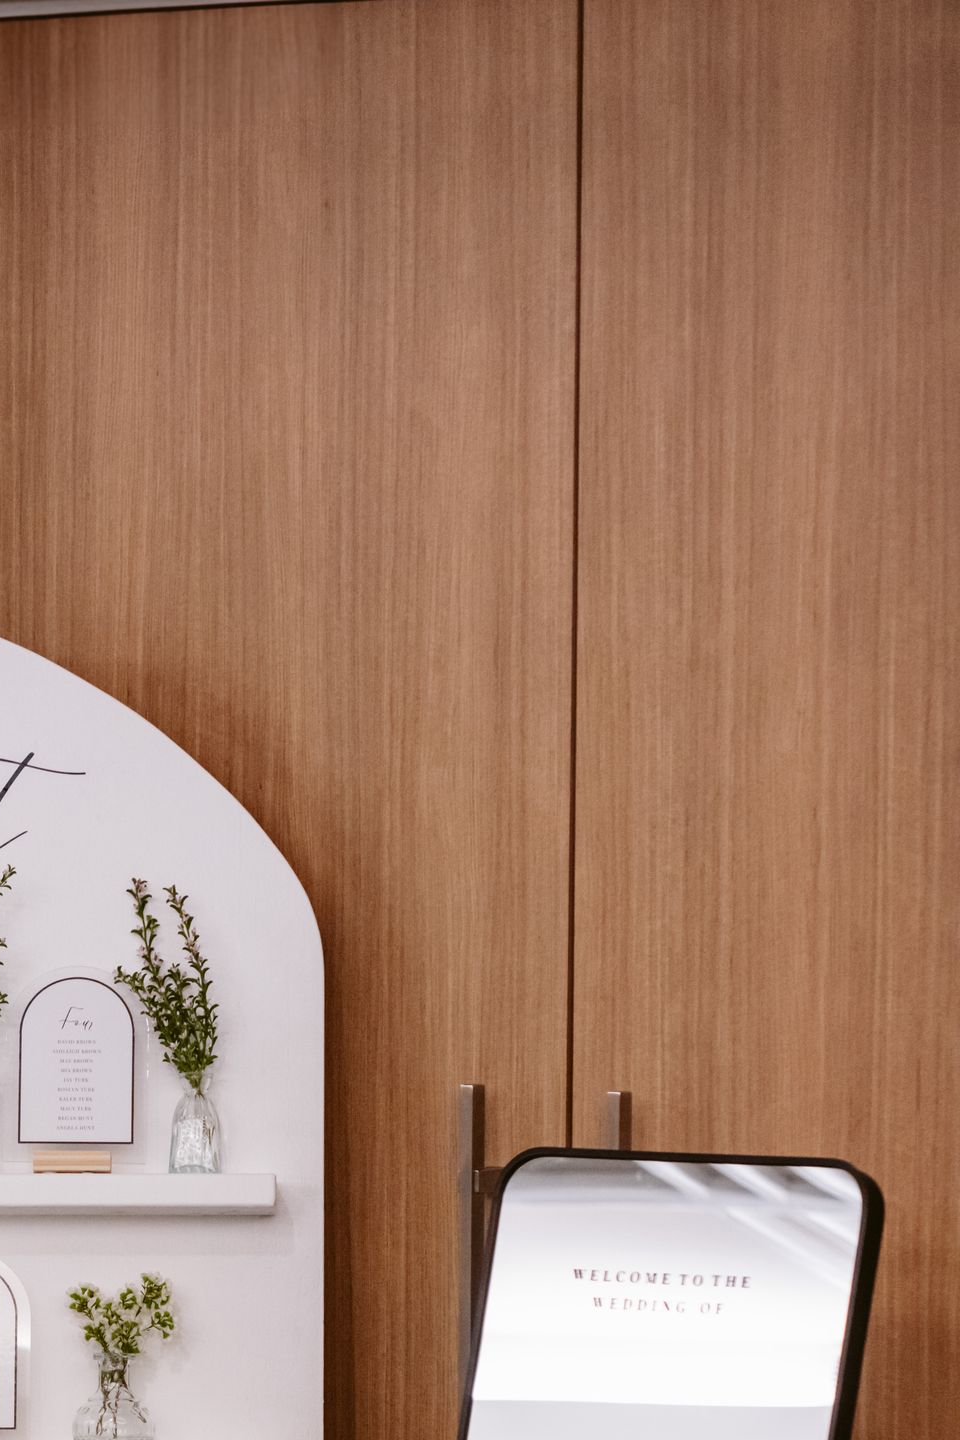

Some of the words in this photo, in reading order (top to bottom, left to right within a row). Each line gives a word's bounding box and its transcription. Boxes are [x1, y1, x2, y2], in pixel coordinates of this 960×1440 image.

[59, 1007, 93, 1030] Four
[573, 1268, 671, 1286] WELCOME
[680, 1273, 704, 1287] TO
[712, 1274, 752, 1289] THE
[592, 1296, 686, 1314] WEDDING
[700, 1303, 725, 1315] OF
